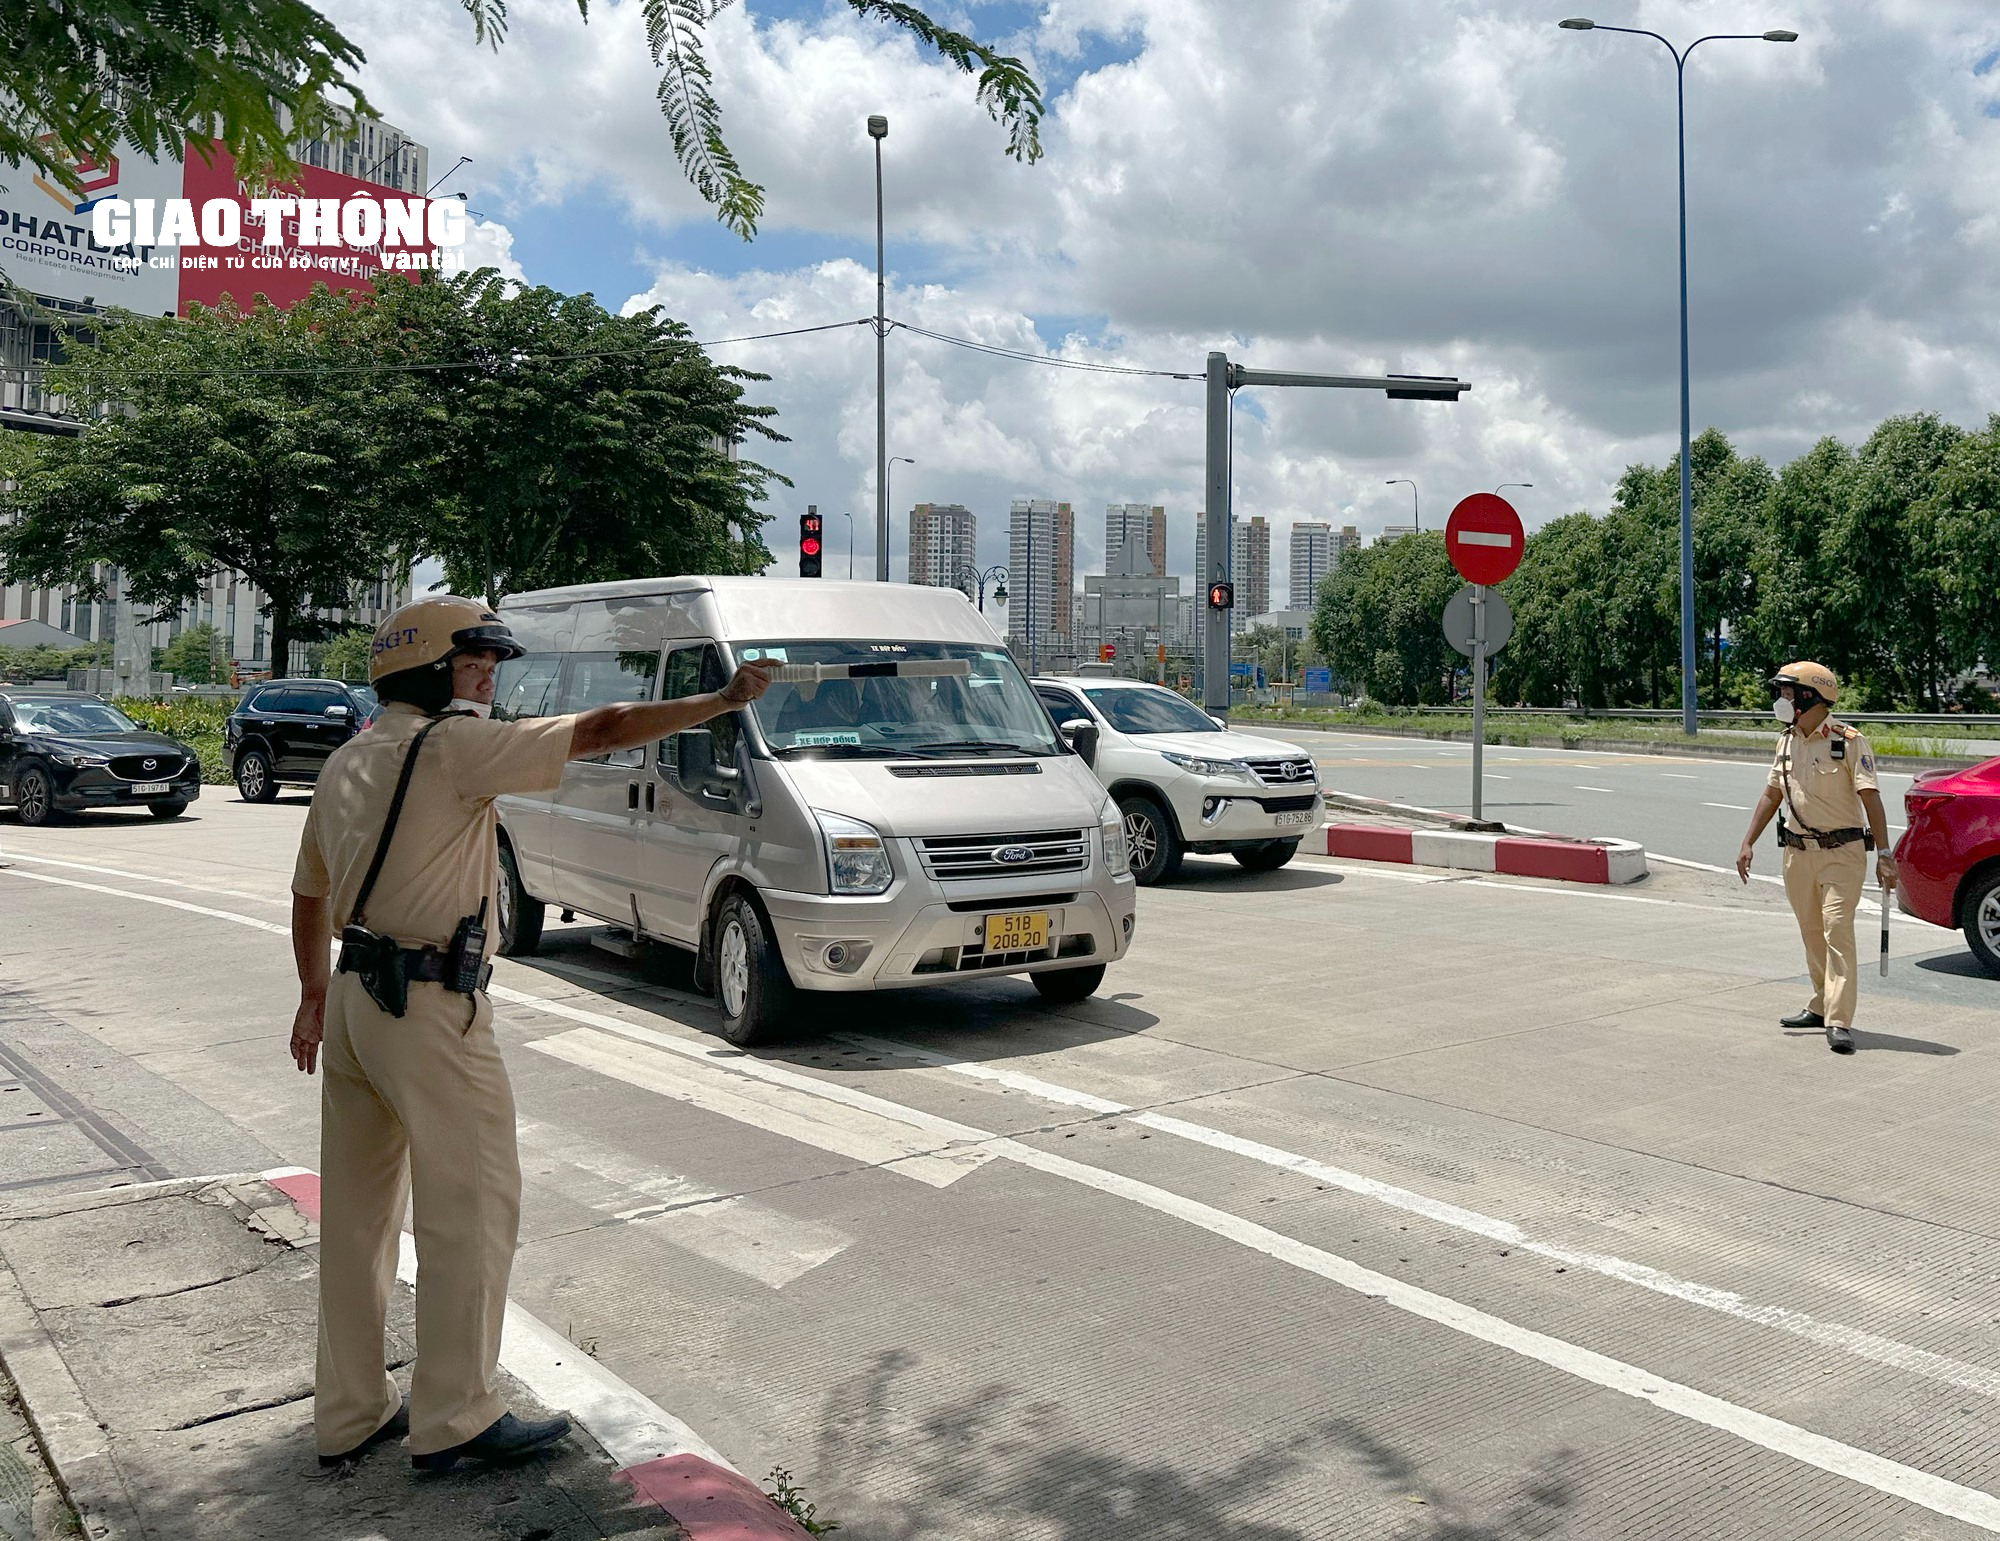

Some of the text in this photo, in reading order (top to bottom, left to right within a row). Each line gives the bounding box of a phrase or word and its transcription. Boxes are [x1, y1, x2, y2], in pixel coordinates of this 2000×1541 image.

[16, 252, 126, 282] Real Estate Development
[1003, 848, 1027, 860] Ford
[1004, 915, 1031, 932] 51B
[992, 931, 1041, 950] 208.20
